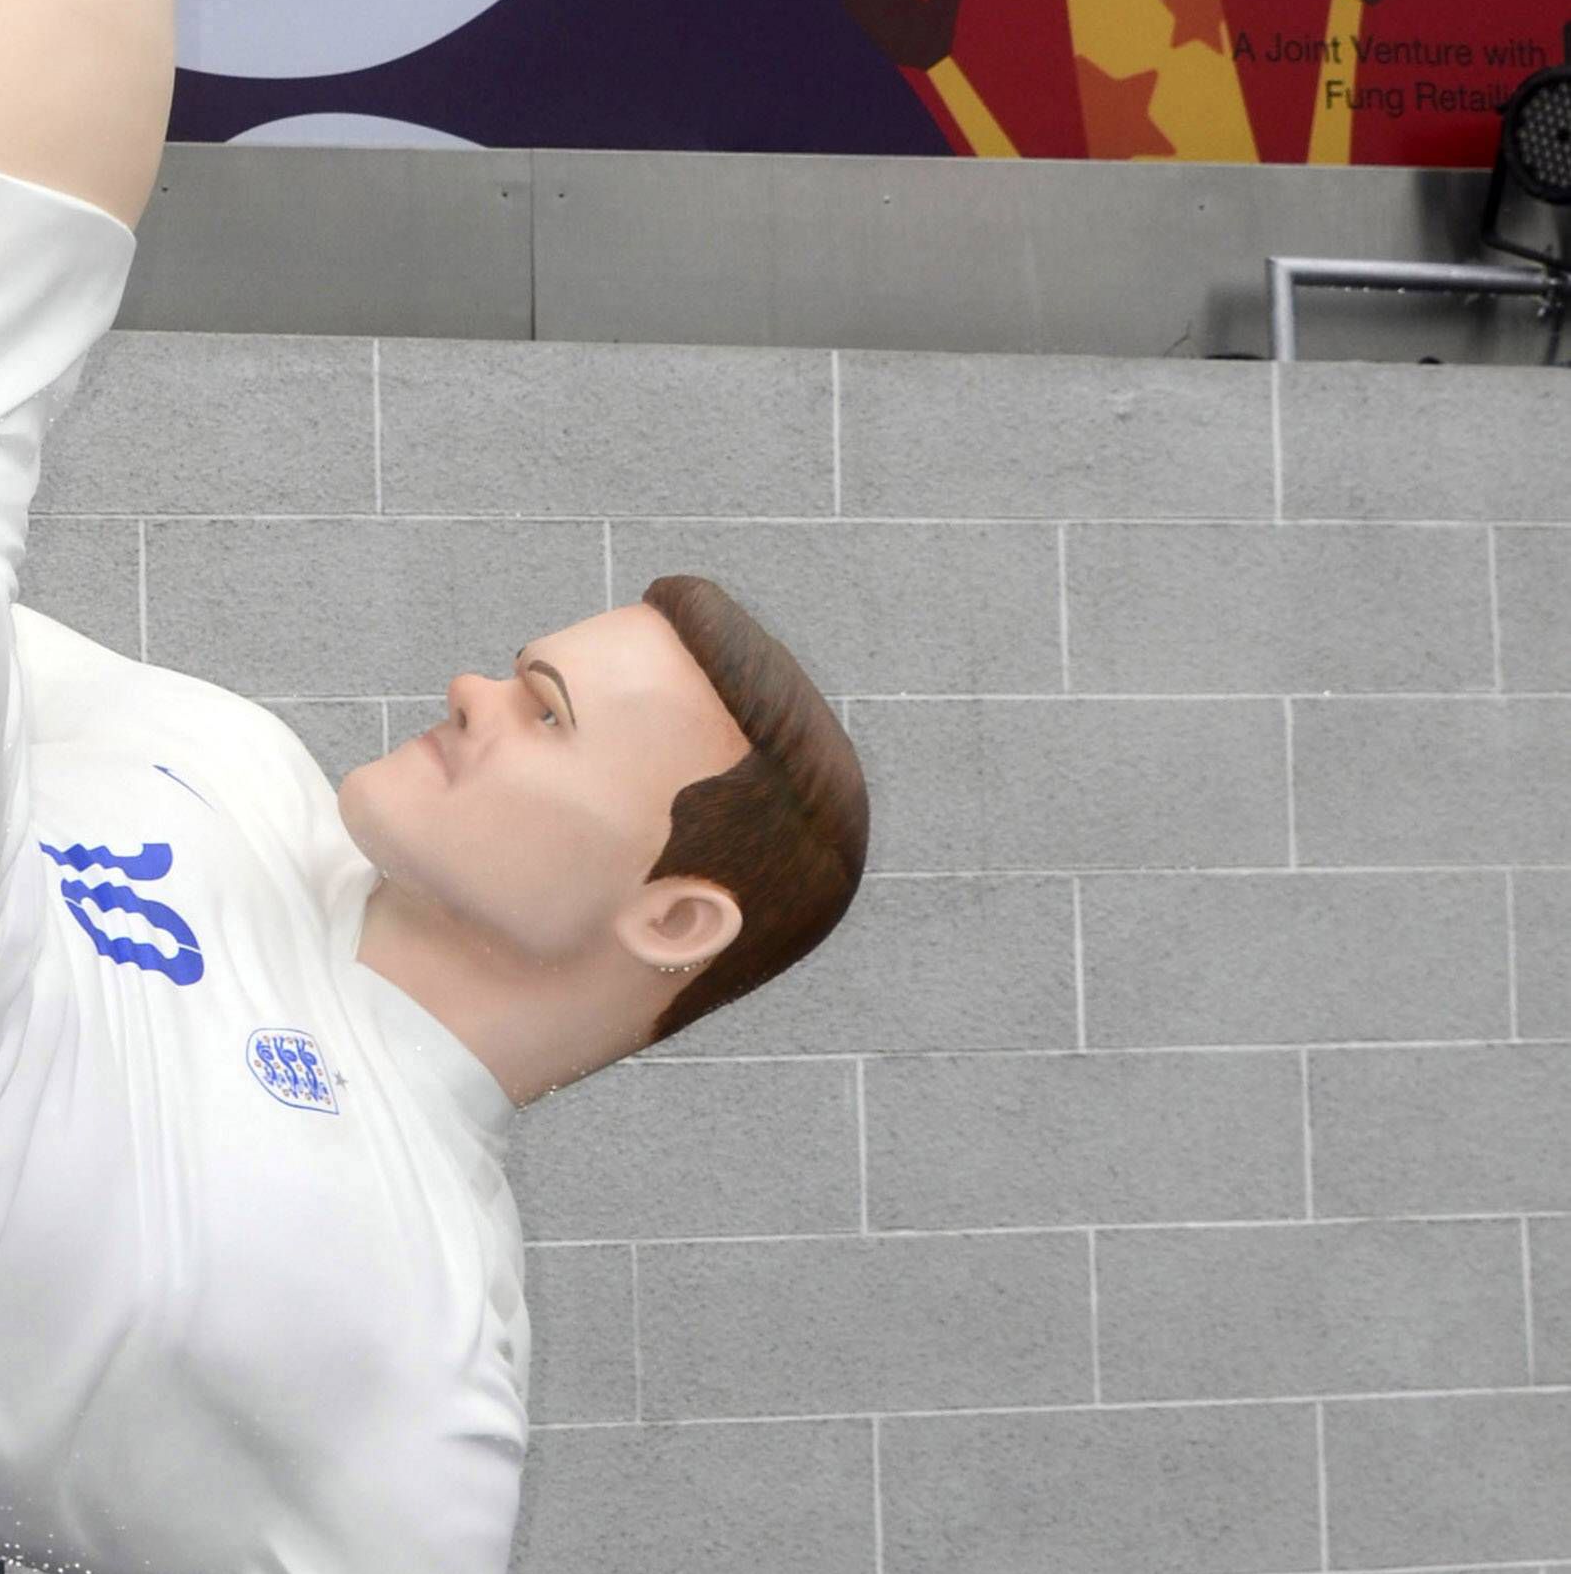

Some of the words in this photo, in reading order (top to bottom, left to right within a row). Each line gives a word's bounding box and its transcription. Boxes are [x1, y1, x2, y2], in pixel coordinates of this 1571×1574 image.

[1233, 31, 1256, 64] A
[1265, 32, 1342, 65] Joint
[1354, 33, 1474, 67] Venture
[1483, 36, 1548, 70] with
[1324, 78, 1405, 117] Fung
[37, 841, 206, 987] 10
